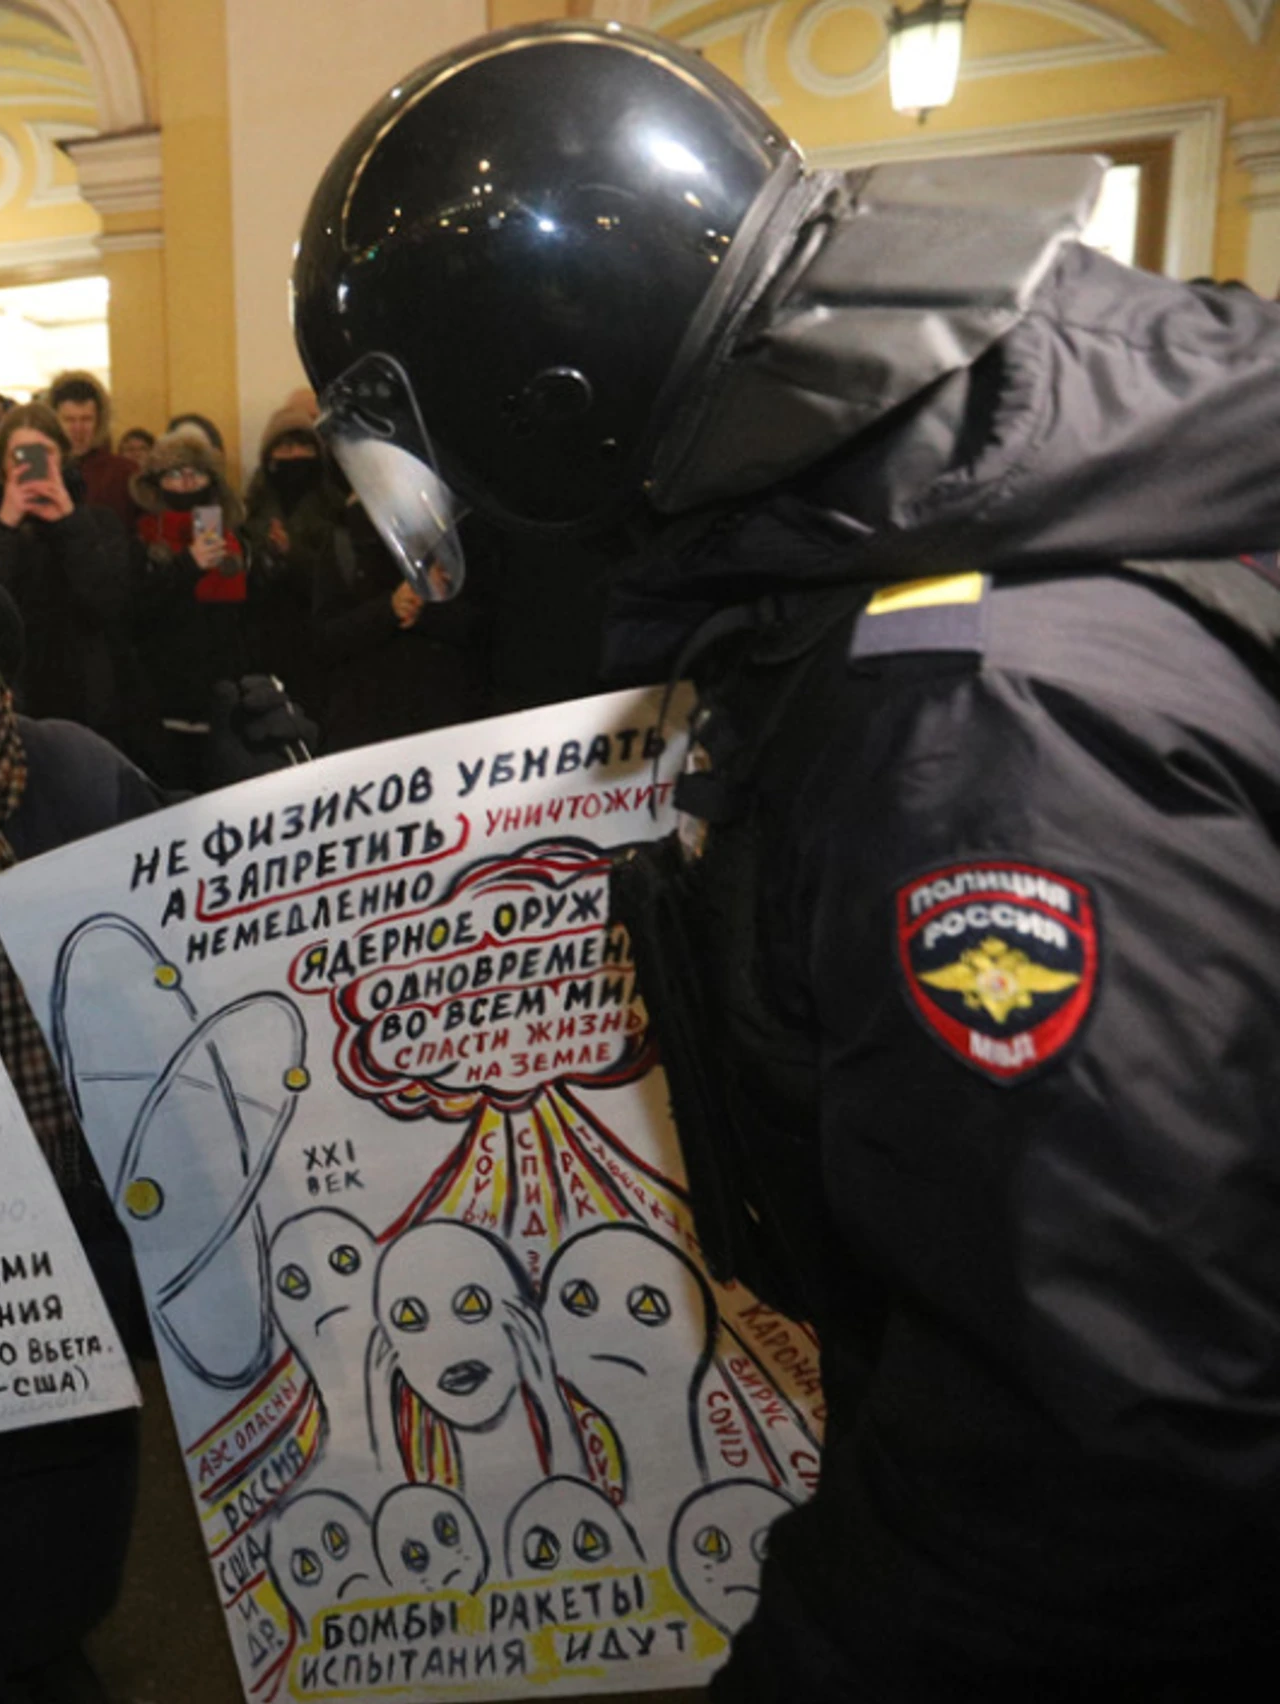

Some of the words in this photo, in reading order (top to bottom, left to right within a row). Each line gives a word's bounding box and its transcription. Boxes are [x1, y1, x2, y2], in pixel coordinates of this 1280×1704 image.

[130, 839, 191, 892] НЕ
[202, 766, 434, 867] ФИЗИКОВ
[457, 727, 662, 798] УБИВАТЬ
[161, 887, 187, 928] А
[208, 819, 445, 911] ЗАПРЕТИТЬ
[485, 782, 673, 837] УНИЧТОЖИТ
[186, 871, 435, 963] НЕМЕДЛЕННО
[910, 869, 1072, 916] ПОЛИЦИЯ
[923, 903, 1069, 950] РОССИЯ
[300, 912, 477, 985] ЯДЕРНОЕ
[493, 886, 605, 937] ОРУЖ
[370, 934, 631, 1011] ОДНОВРЕМЕН
[381, 1010, 427, 1043] ВО
[443, 985, 547, 1032] ВСЕМ
[564, 975, 634, 1012] МИ
[394, 1027, 511, 1071] СПАСТИ
[526, 1006, 644, 1046] ЖИЗНЬ
[466, 1059, 503, 1083] НА
[510, 1043, 612, 1077] ЗЕМЛЕ
[302, 1138, 356, 1172] XXI
[305, 1168, 365, 1195] ВЕК
[560, 1150, 598, 1219] РАК
[707, 1390, 749, 1468] COVID
[222, 1437, 305, 1534] РОССИЯ
[220, 1533, 267, 1595] США
[237, 1594, 259, 1621] И
[322, 1600, 460, 1651] БОМБЫ
[488, 1574, 645, 1631] РАКЕТЫ
[300, 1638, 528, 1691] ИСПЫТАНИЯ
[565, 1621, 688, 1664] ИДУТ
